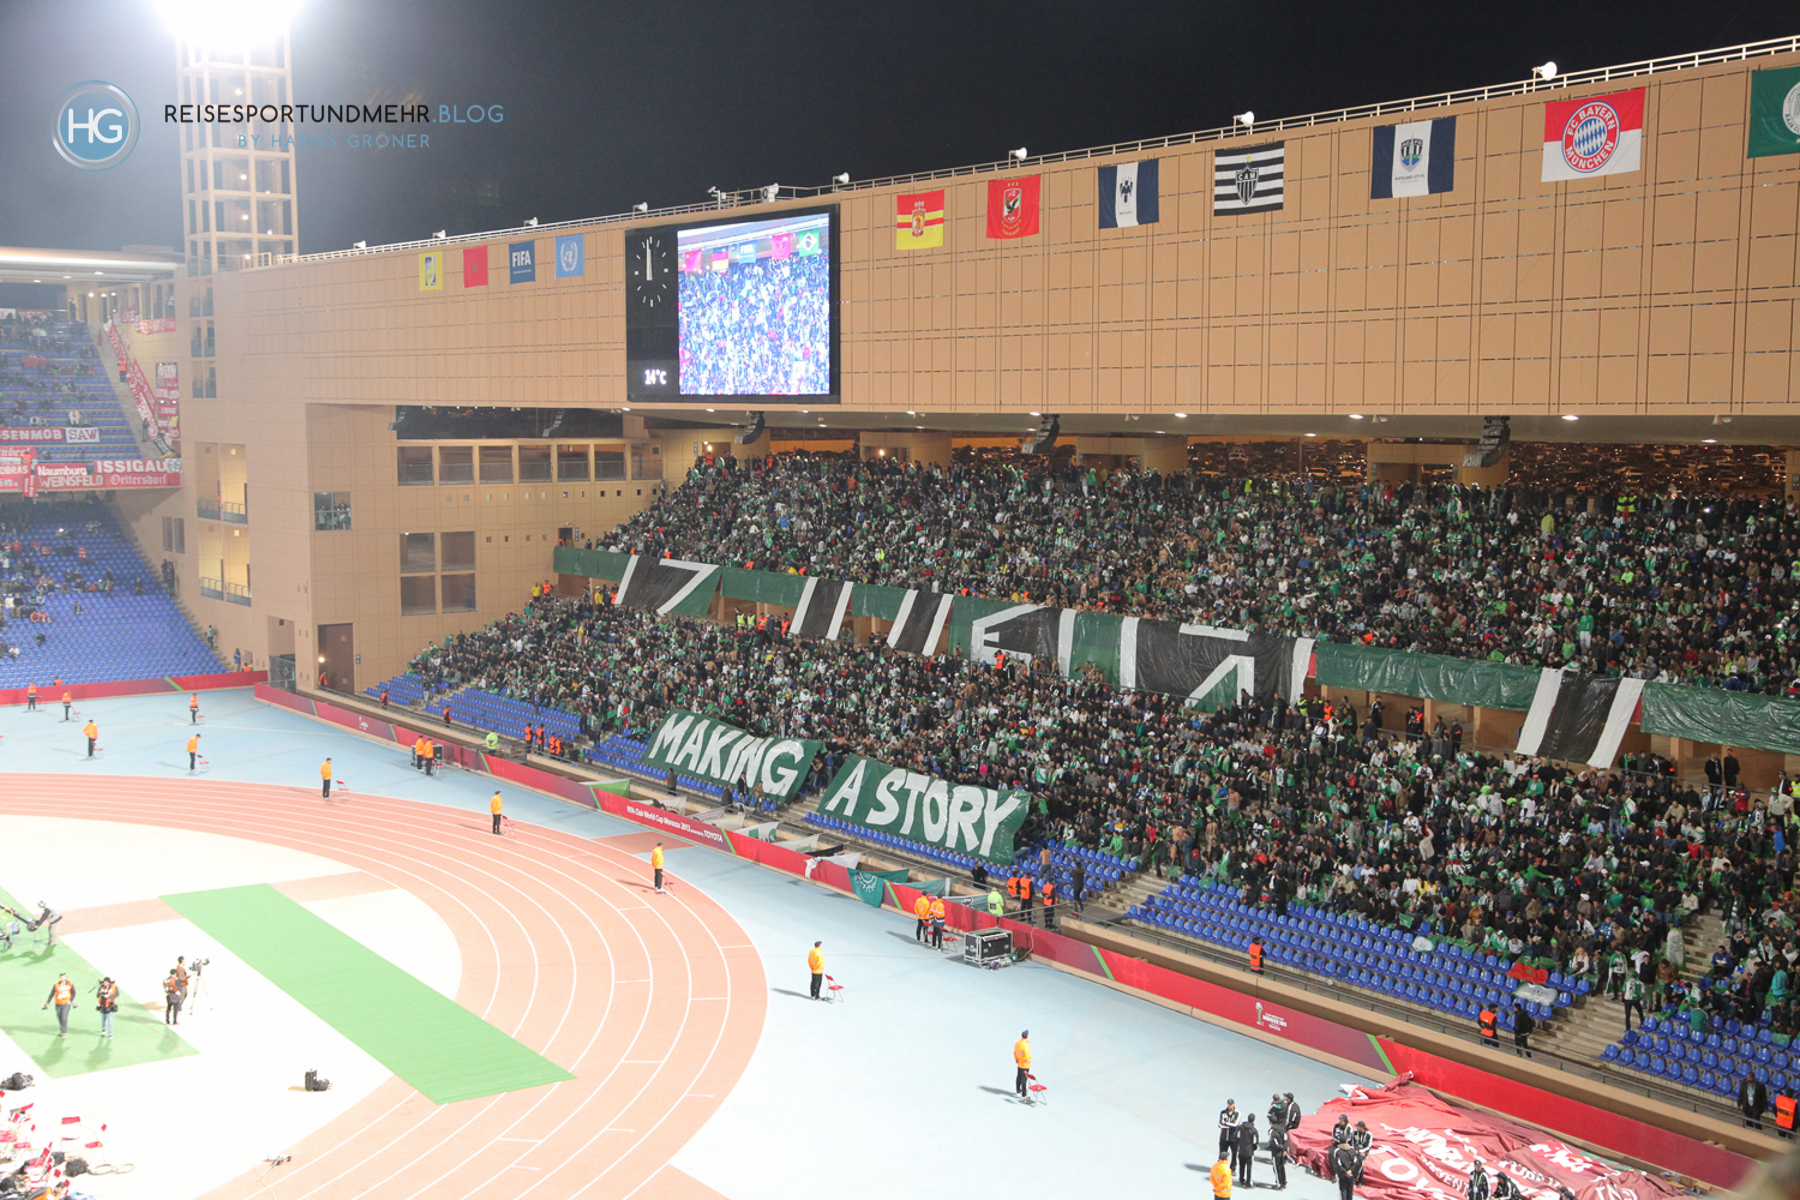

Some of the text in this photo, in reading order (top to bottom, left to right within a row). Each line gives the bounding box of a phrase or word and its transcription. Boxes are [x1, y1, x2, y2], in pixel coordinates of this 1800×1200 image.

[1567, 105, 1616, 136] FC BAYERN
[1237, 172, 1257, 181] CAM
[512, 250, 532, 267] FIFA
[0, 429, 62, 440] SENMOB
[68, 429, 98, 440] SAW
[96, 460, 167, 473] ISSIGAU
[38, 474, 104, 487] WEINSFELD
[109, 474, 167, 485] Oettersdorf
[648, 712, 804, 797] MAKING
[825, 759, 1021, 858] A STORY
[643, 810, 656, 821] World
[663, 816, 681, 829] Morocco
[680, 822, 691, 832] 2013
[703, 829, 723, 842] TOYOTA
